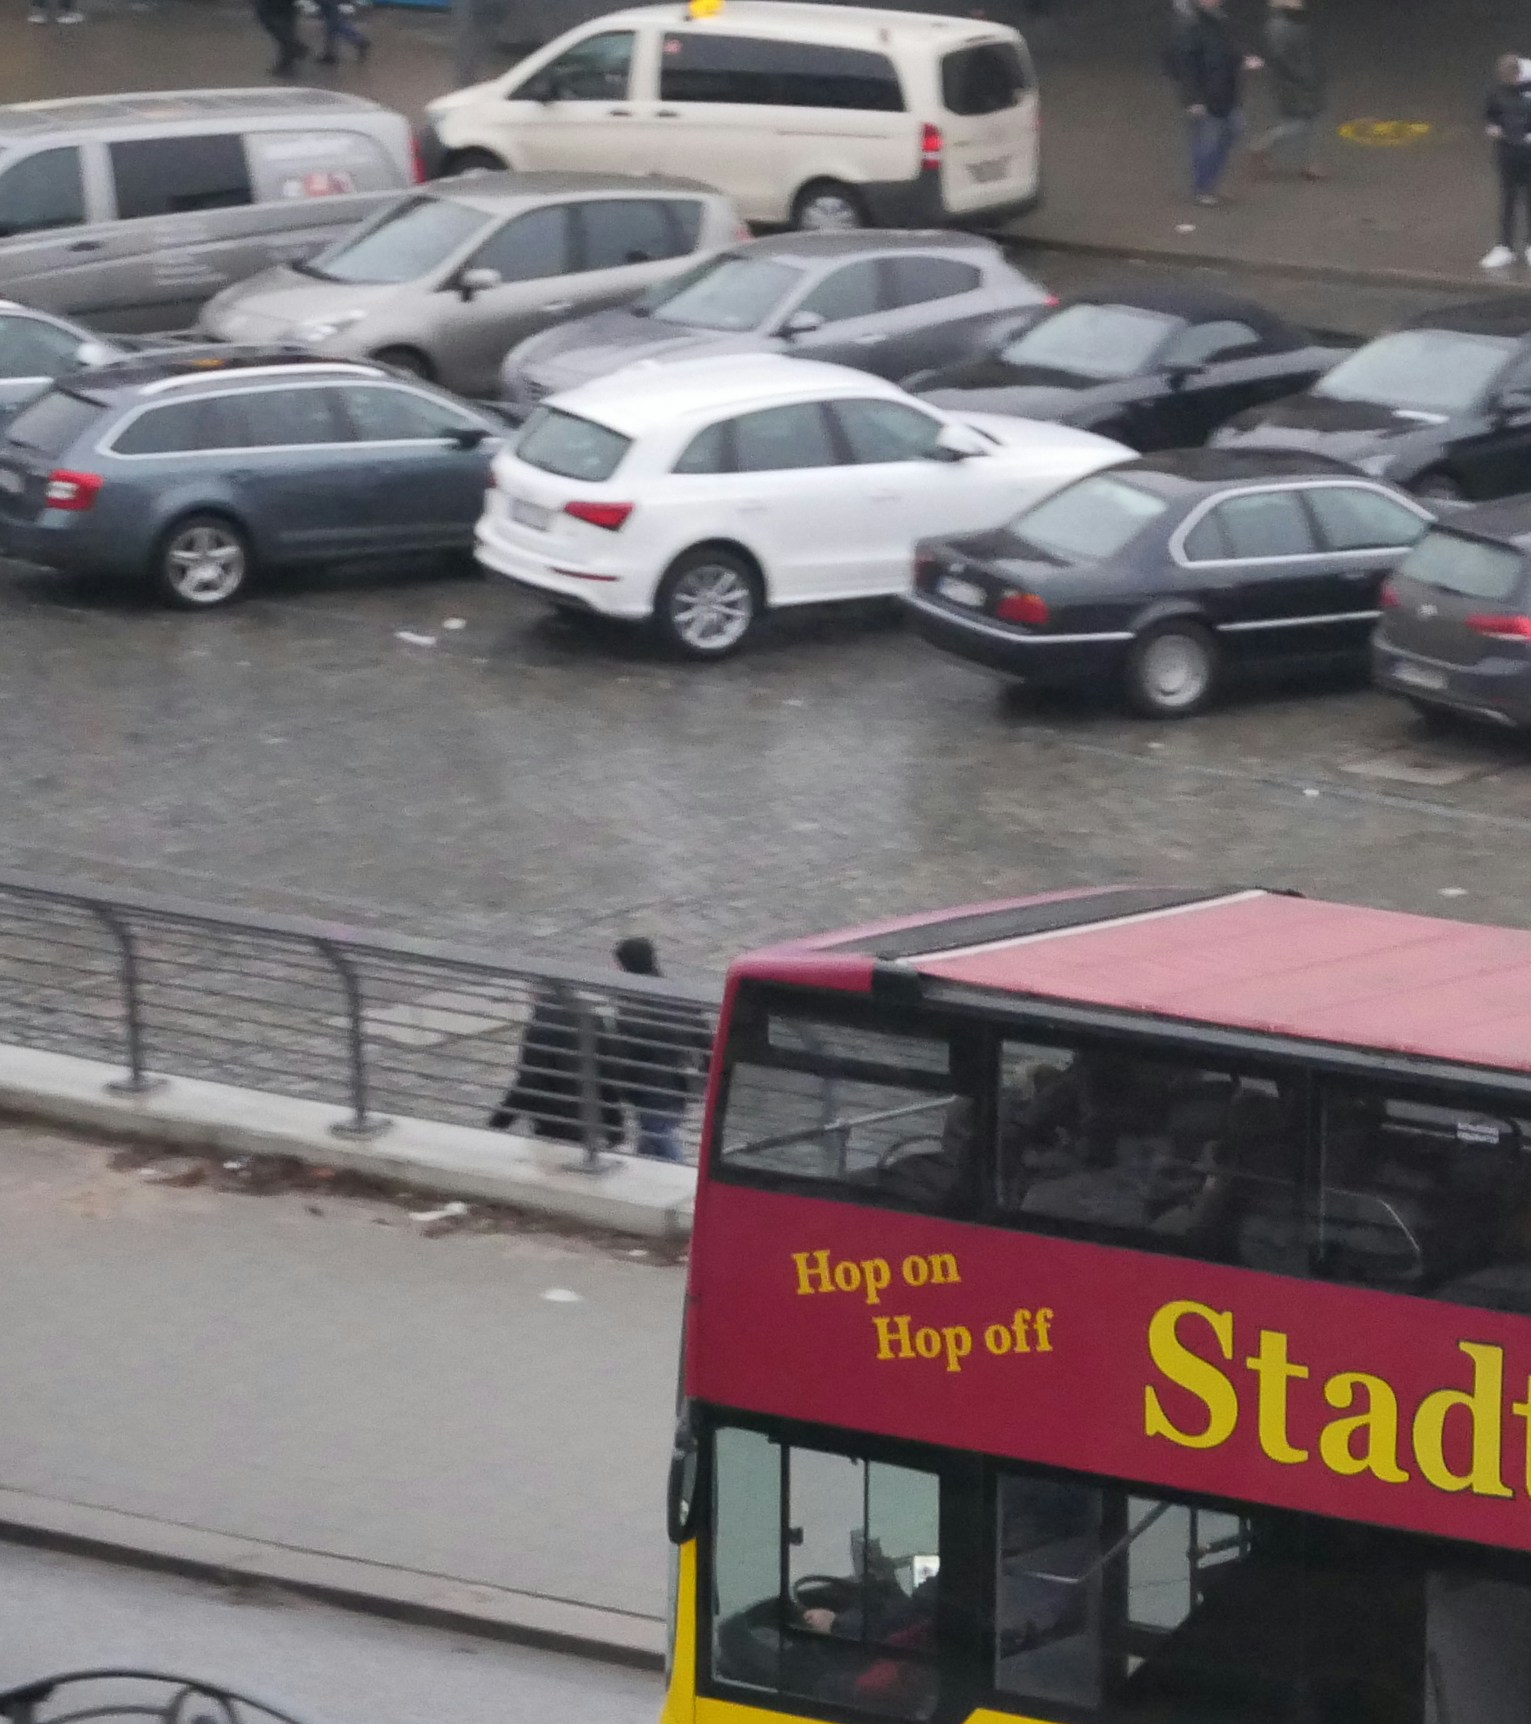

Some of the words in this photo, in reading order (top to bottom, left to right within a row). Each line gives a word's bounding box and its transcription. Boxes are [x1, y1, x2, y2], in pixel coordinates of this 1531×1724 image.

[793, 1250, 891, 1305] Hop
[902, 1253, 960, 1286] on
[873, 1315, 972, 1372] Hop
[985, 1308, 1054, 1355] off
